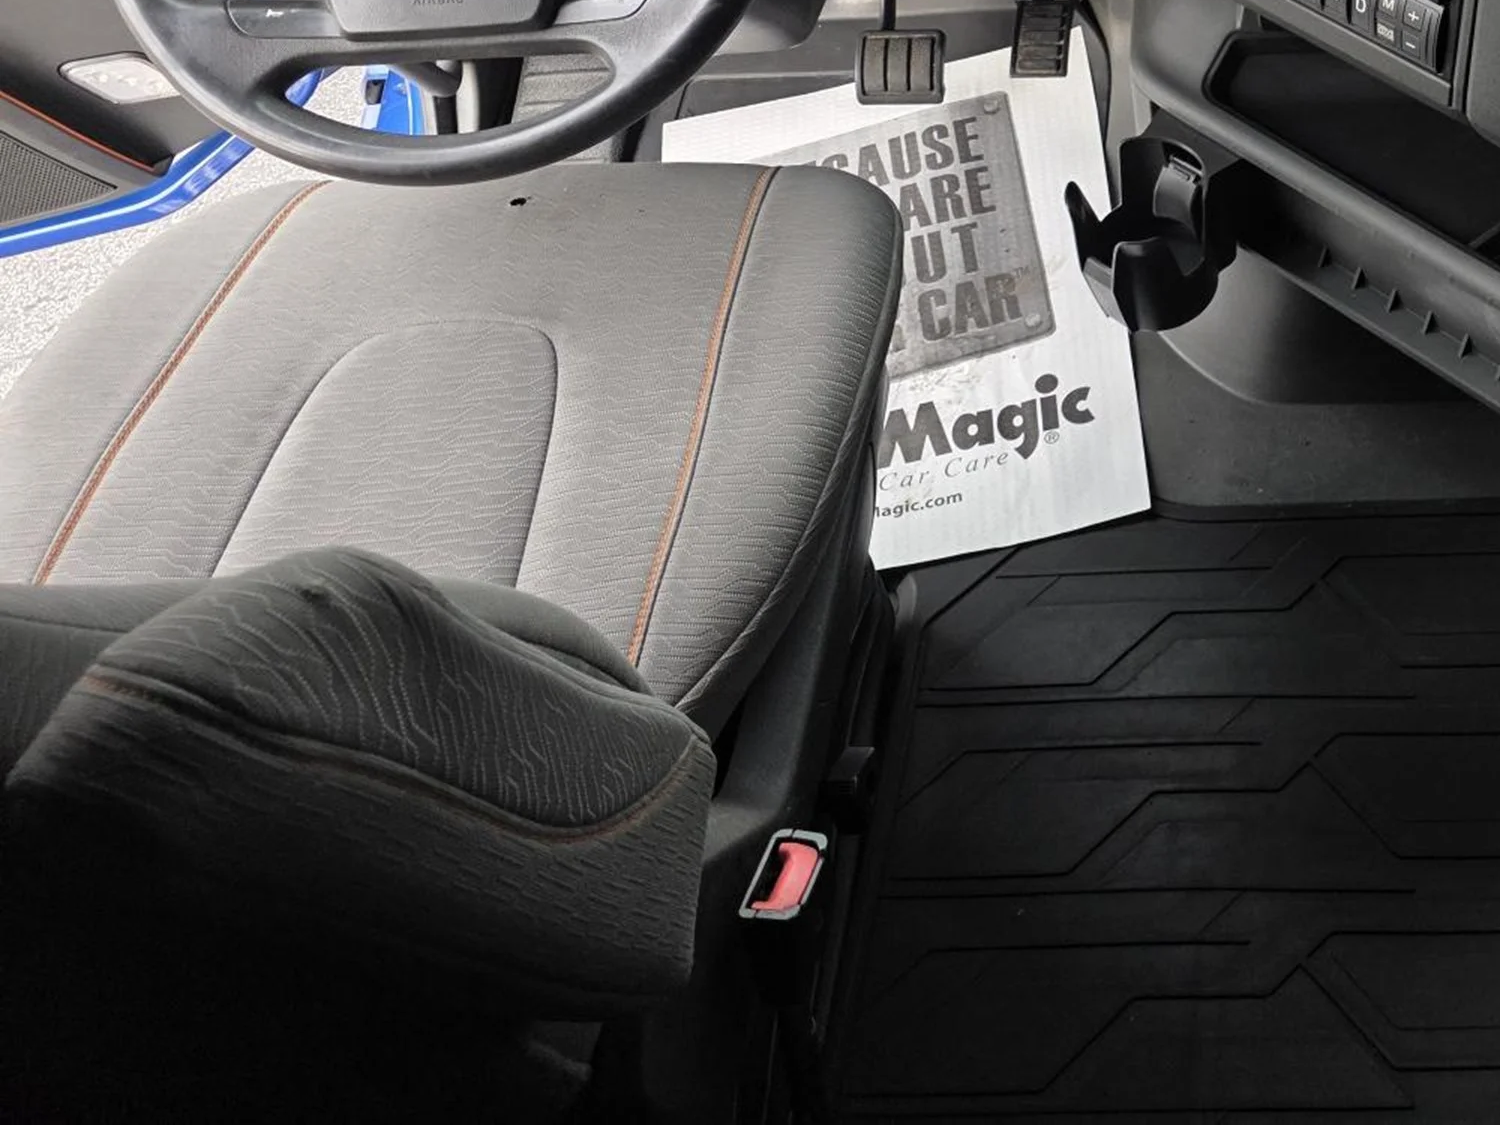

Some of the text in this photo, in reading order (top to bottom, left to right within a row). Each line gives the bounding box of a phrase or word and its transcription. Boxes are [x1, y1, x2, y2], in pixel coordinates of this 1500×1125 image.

[899, 165, 997, 231] ARE
[879, 452, 1009, 492] Car Care
